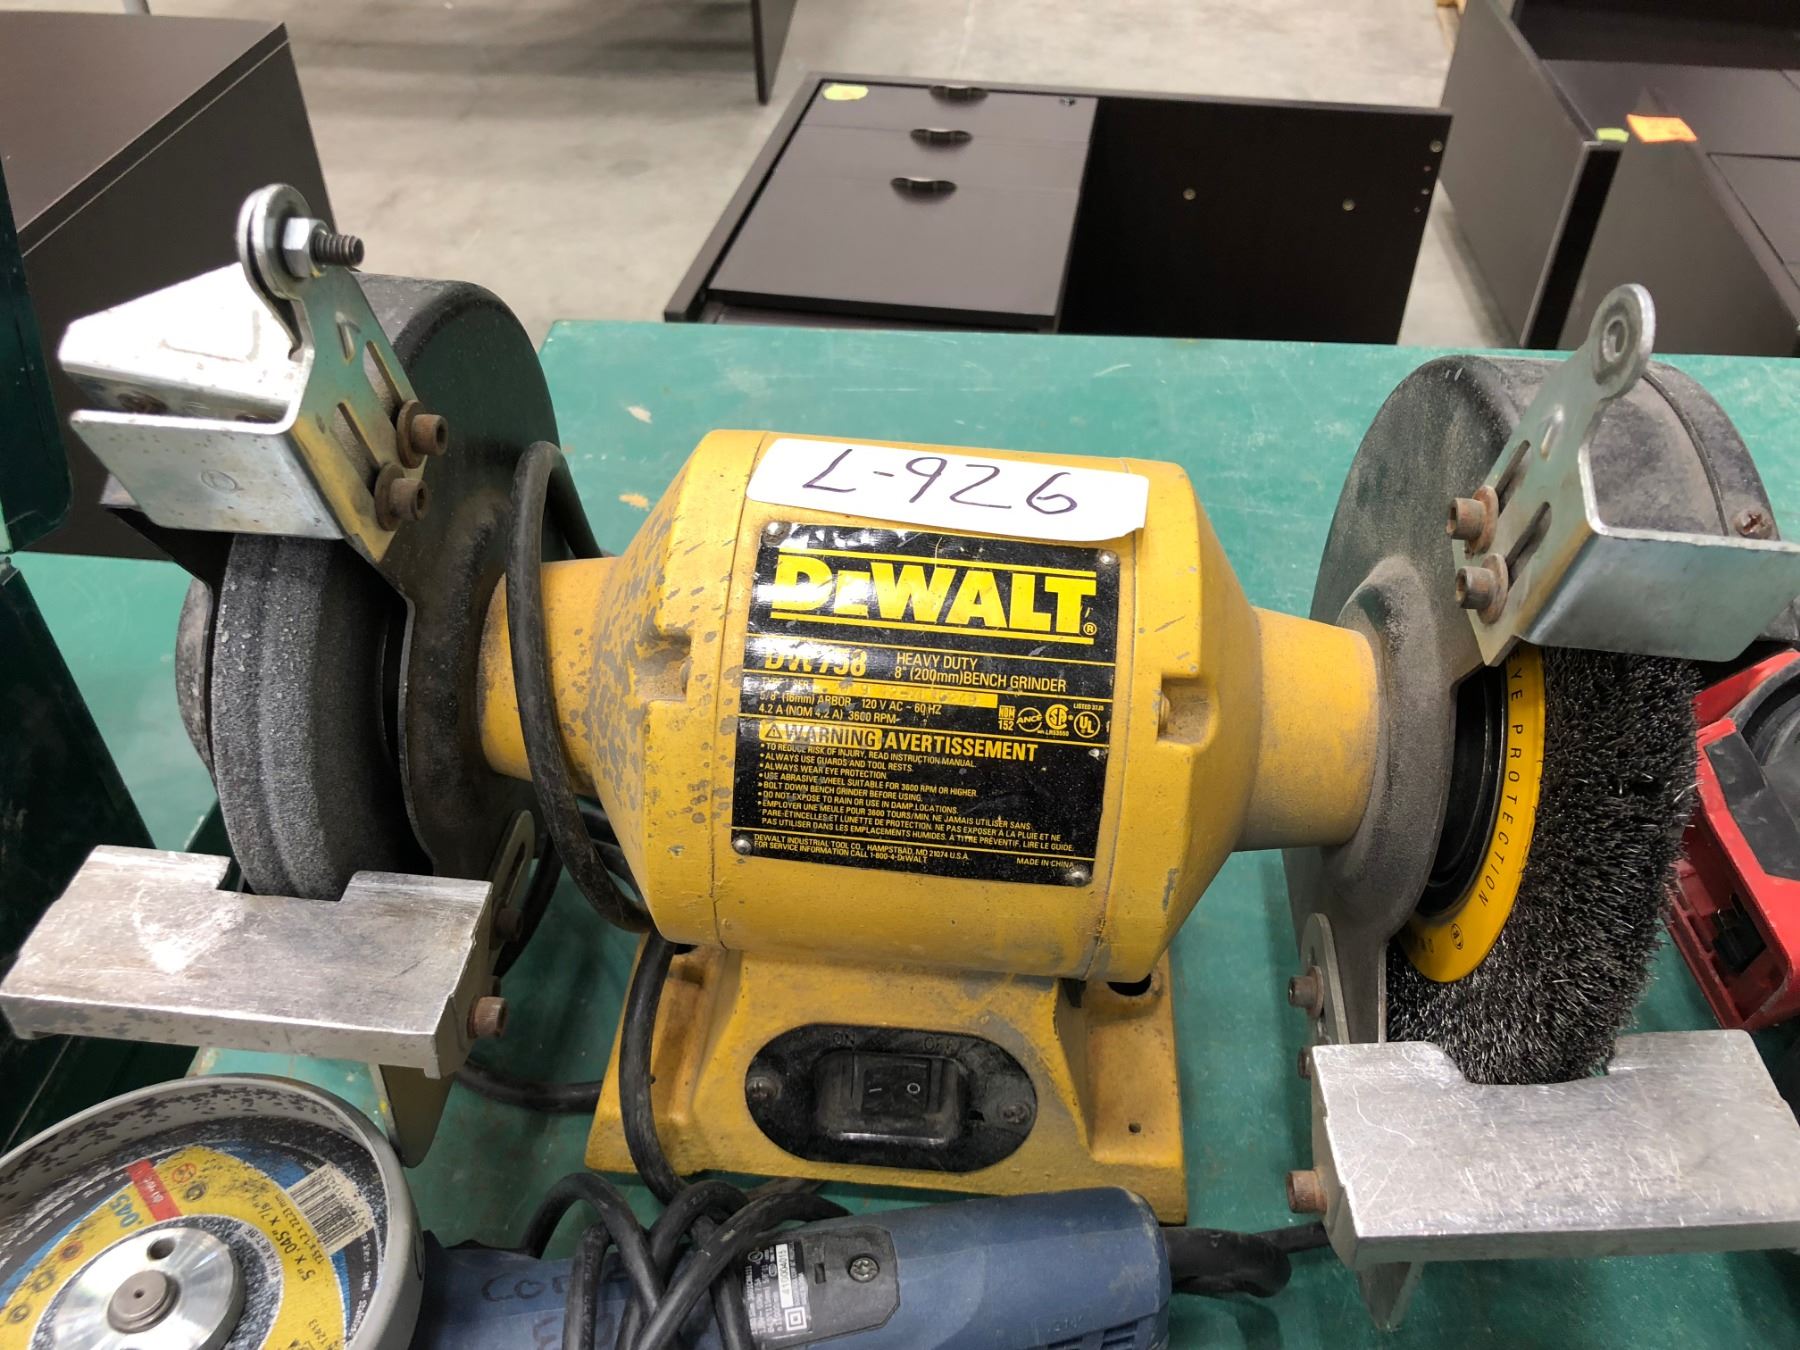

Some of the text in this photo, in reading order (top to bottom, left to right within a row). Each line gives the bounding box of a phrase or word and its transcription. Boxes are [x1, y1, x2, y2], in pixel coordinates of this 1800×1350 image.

[802, 448, 1078, 515] L-926
[896, 652, 977, 670] HEAVY DUTY
[1009, 675, 1066, 692] GRINDER
[758, 703, 772, 713] 4.2
[775, 704, 783, 714] A
[785, 705, 812, 717] (NOM
[832, 709, 843, 719] A)
[847, 710, 871, 722] 3600
[873, 712, 896, 724] RPM
[817, 695, 851, 707] ARBOR
[861, 698, 876, 709] 120
[878, 700, 886, 710] V
[888, 701, 903, 711] AC
[913, 703, 925, 713] 60
[927, 704, 942, 714] HZ
[997, 720, 1014, 730] 152
[1077, 715, 1096, 733] UL
[784, 723, 1038, 761] WARNING AVERTISSEMENT
[765, 752, 798, 762] ALWAYS
[800, 755, 815, 763] USE
[816, 756, 847, 766] GUARDS
[849, 759, 865, 768] AND
[867, 760, 886, 769] TOOL
[766, 742, 775, 750] TO
[807, 746, 823, 754] RISK
[826, 747, 836, 755] OF
[837, 748, 866, 758] INJURY,
[868, 751, 888, 759] READ
[890, 753, 939, 764] INSTRUCTION
[941, 757, 975, 767] MANUAL.
[764, 761, 798, 771] ALWAYS
[800, 765, 823, 774] WEAR
[824, 767, 838, 775] EYE
[1477, 650, 1524, 907] EYE PROTECTION
[763, 780, 922, 801] BOLT DOWN BENCH GRINDER BEFORE USING.
[764, 771, 778, 779] USE
[780, 772, 816, 782] ABRASIVE
[847, 778, 883, 788] SUITABLE
[885, 781, 898, 789] FOR
[901, 783, 918, 791] 3600
[920, 785, 936, 793] RPM
[938, 786, 947, 794] OR
[763, 790, 773, 798] DO
[775, 791, 789, 799] NOT
[792, 792, 820, 802] EXPOSE
[822, 795, 831, 803] TO
[833, 796, 851, 804] RAIN
[865, 799, 879, 807] USE
[881, 800, 889, 808] IN
[891, 801, 913, 810] DAMP
[914, 803, 958, 814] LOCATIONS.
[762, 799, 801, 809] EMPLOYER
[803, 803, 817, 811] UNE
[819, 804, 846, 813] MEULE
[846, 806, 865, 815] POUR
[867, 808, 884, 817] 3600
[932, 814, 941, 822] NE
[944, 815, 973, 824] JAMAIS
[975, 818, 1008, 827] UTILISER
[762, 817, 777, 825] PAS
[779, 819, 812, 828] UTILISER
[813, 822, 833, 830] DANS
[850, 825, 910, 837] EMPLACEMENTS
[956, 834, 977, 843] TITRE
[1023, 840, 1038, 848] LIRE
[839, 815, 872, 824] LUNETTE
[934, 823, 944, 831] NE
[946, 824, 961, 832] PAS
[963, 826, 996, 835] EXPOSER
[1005, 829, 1016, 837] LA
[1017, 830, 1038, 839] PLUIE
[1039, 832, 1049, 840] ET
[1051, 833, 1061, 841] NE
[769, 842, 798, 850] SERVICE
[799, 845, 848, 855] INFORMATION
[850, 849, 868, 857] CALL
[787, 836, 828, 846] INDUSTRIAL
[831, 840, 849, 848] TOOL
[1016, 857, 1038, 865] MADE
